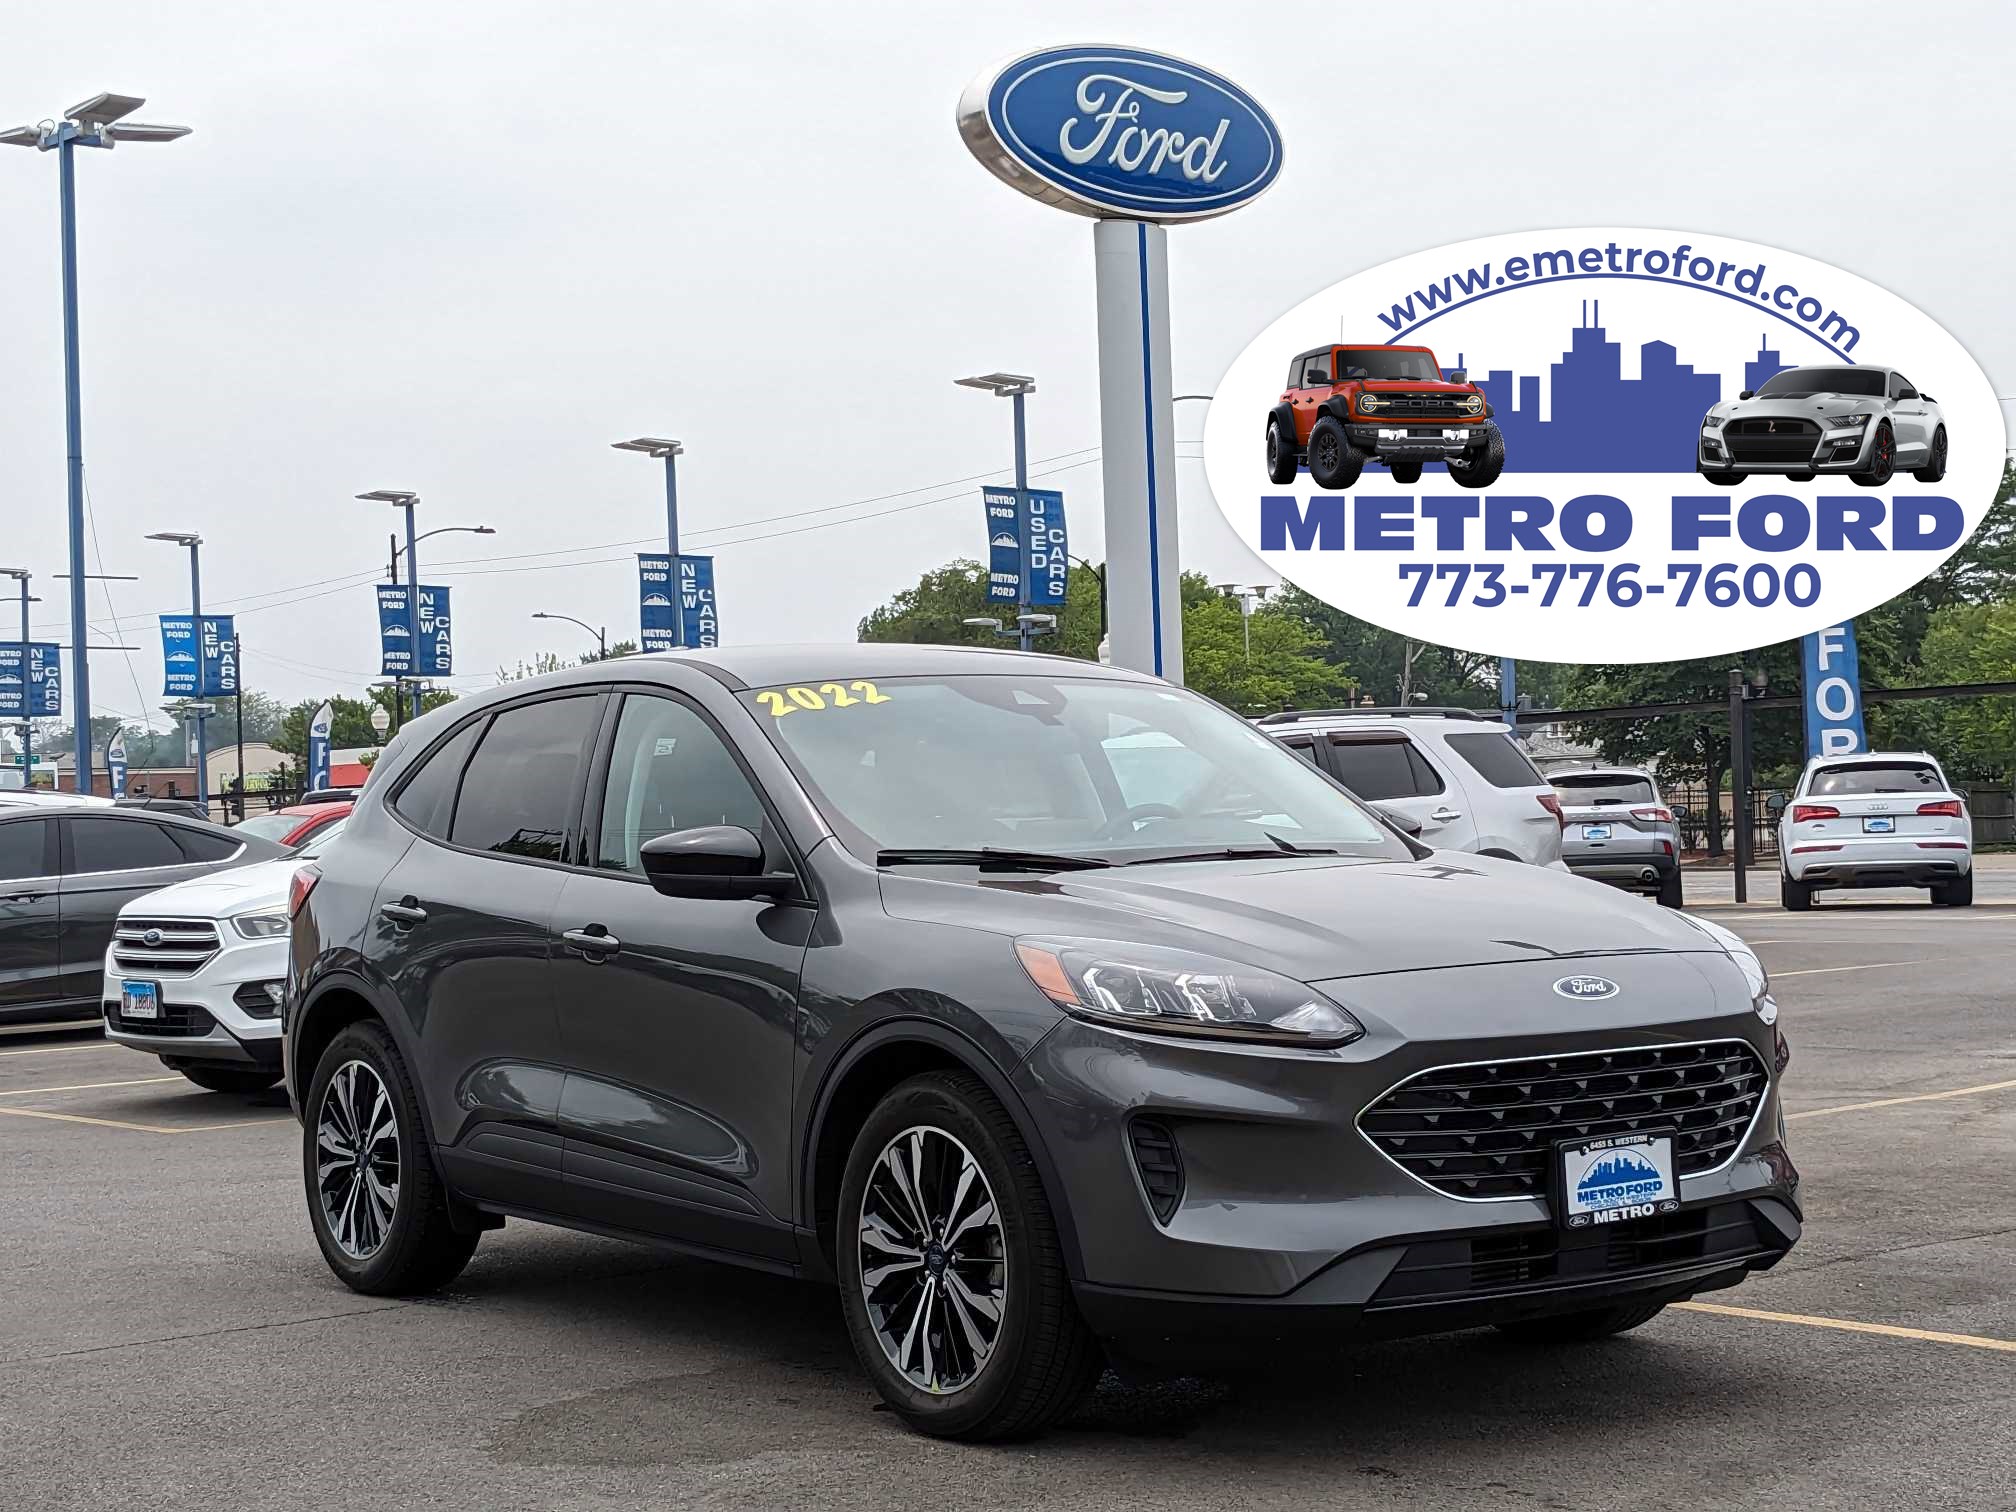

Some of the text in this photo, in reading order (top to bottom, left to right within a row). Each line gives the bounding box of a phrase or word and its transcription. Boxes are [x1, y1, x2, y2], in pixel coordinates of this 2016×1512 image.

[1060, 74, 1230, 183] Ford
[985, 494, 1016, 505] METRO
[990, 507, 1014, 518] FORD
[1030, 499, 1047, 568] USED
[640, 560, 669, 569] METRO
[643, 573, 667, 581] FORD
[990, 573, 1019, 584] METRO
[1048, 529, 1066, 596] CARS
[681, 563, 697, 608] NEW
[992, 586, 1015, 597] FORD
[420, 593, 434, 633] NEW
[699, 589, 716, 648] CARS
[203, 622, 218, 658] NEW
[435, 617, 450, 668] CARS
[642, 629, 672, 637] METRO
[646, 641, 671, 649] FORD
[31, 649, 44, 682] NEW
[220, 641, 236, 689] CARS
[45, 667, 59, 710] CARS
[756, 680, 892, 717] 2022
[1615, 1134, 1648, 1146] WESTERN
[1577, 1180, 1663, 1202] METRO FORD
[1593, 1203, 1655, 1224] METRO
